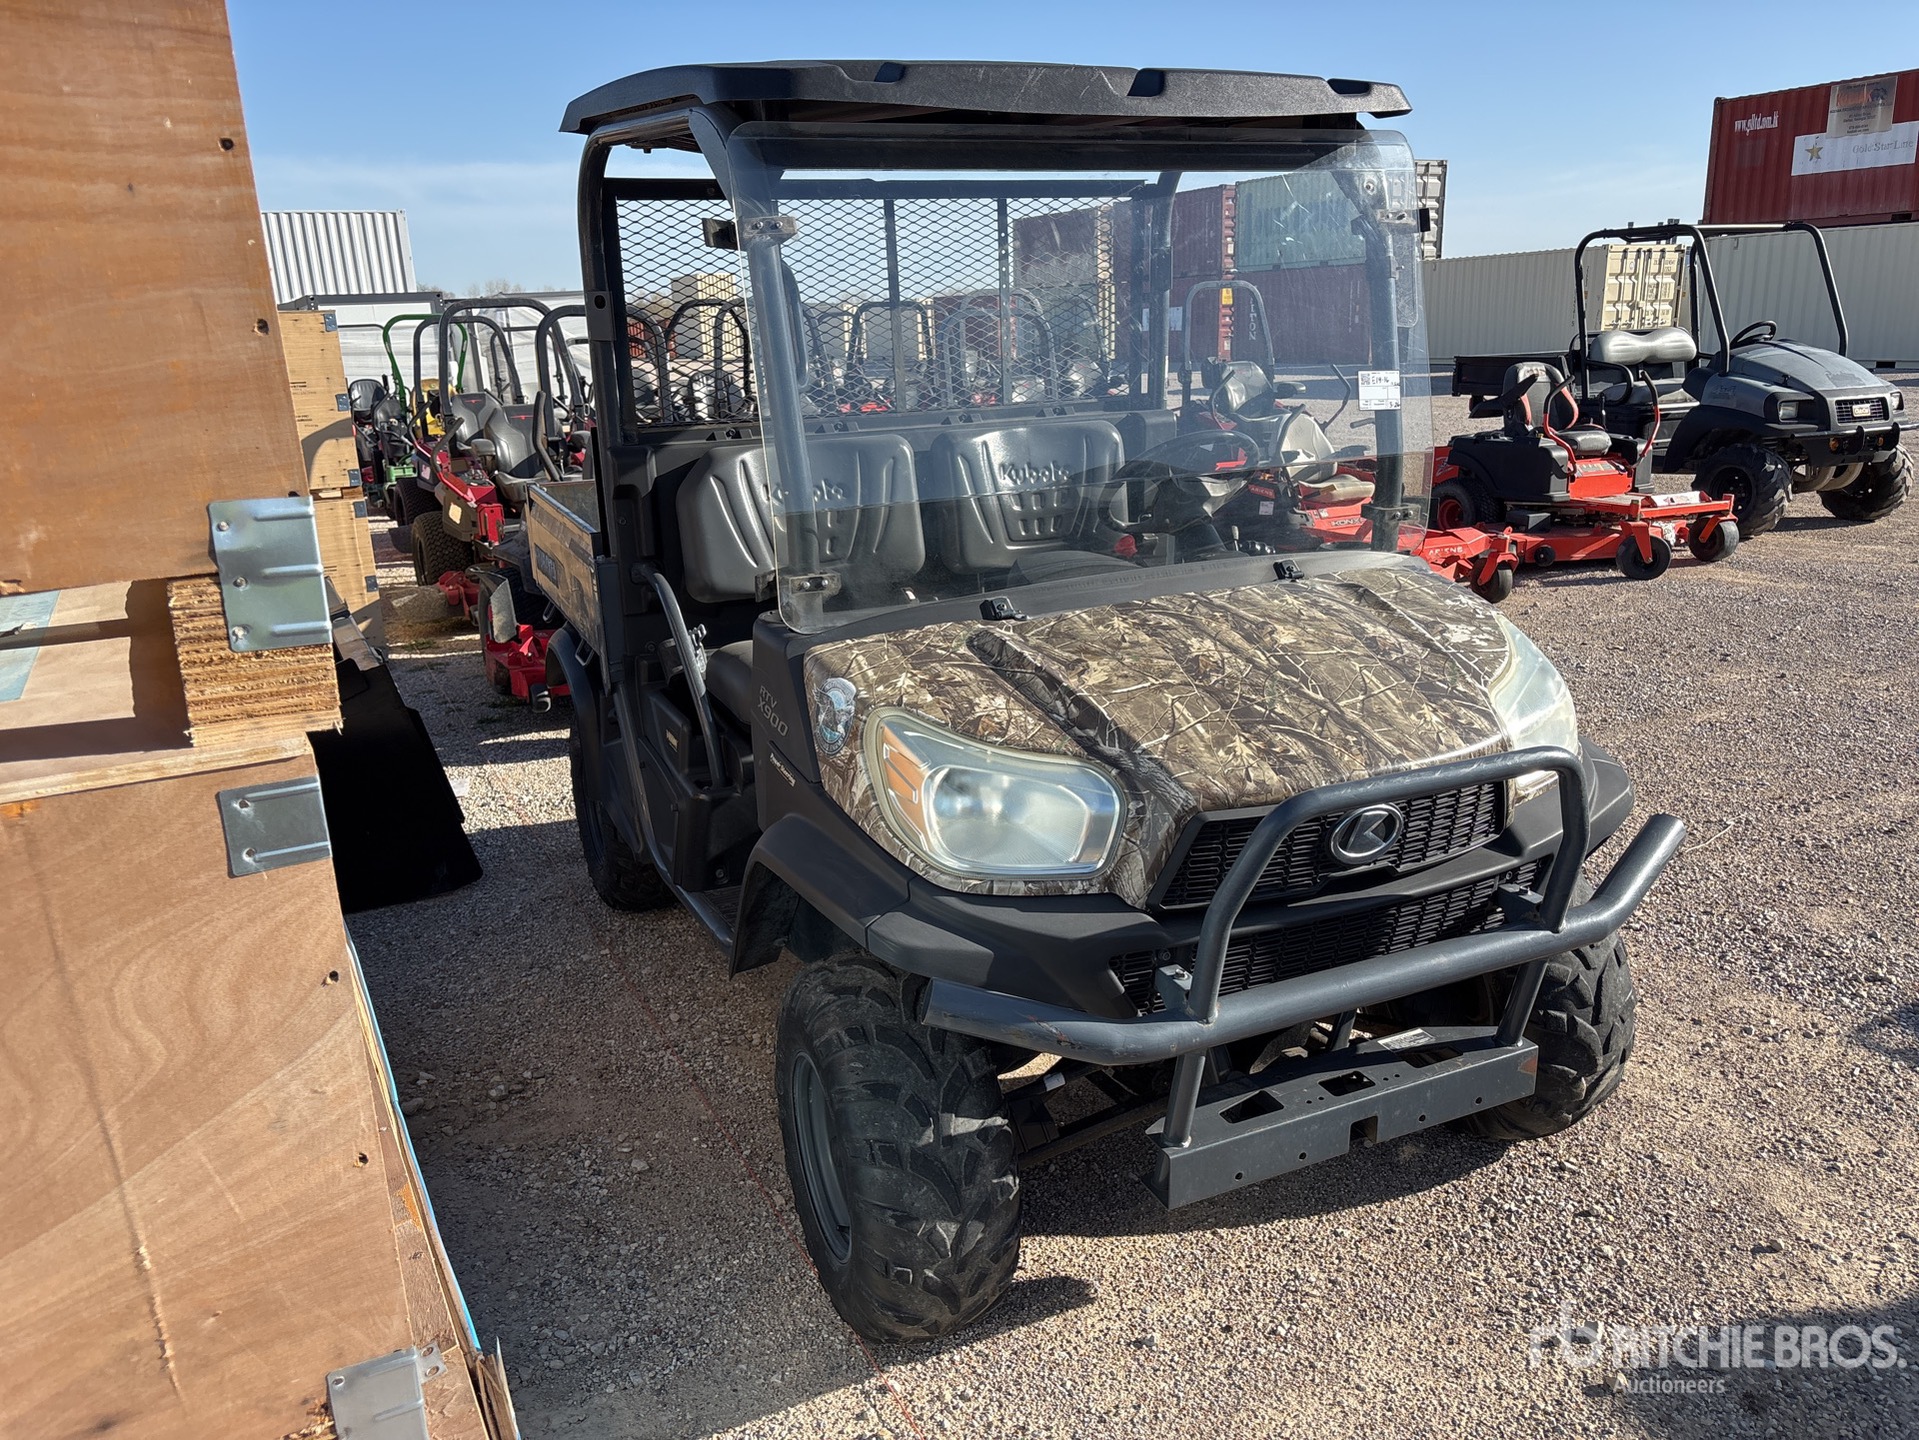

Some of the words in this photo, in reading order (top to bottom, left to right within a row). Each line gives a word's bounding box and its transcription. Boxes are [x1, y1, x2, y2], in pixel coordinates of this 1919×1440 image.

[1000, 461, 1070, 486] Kubota
[760, 685, 777, 708] RTV
[758, 696, 788, 736] X900
